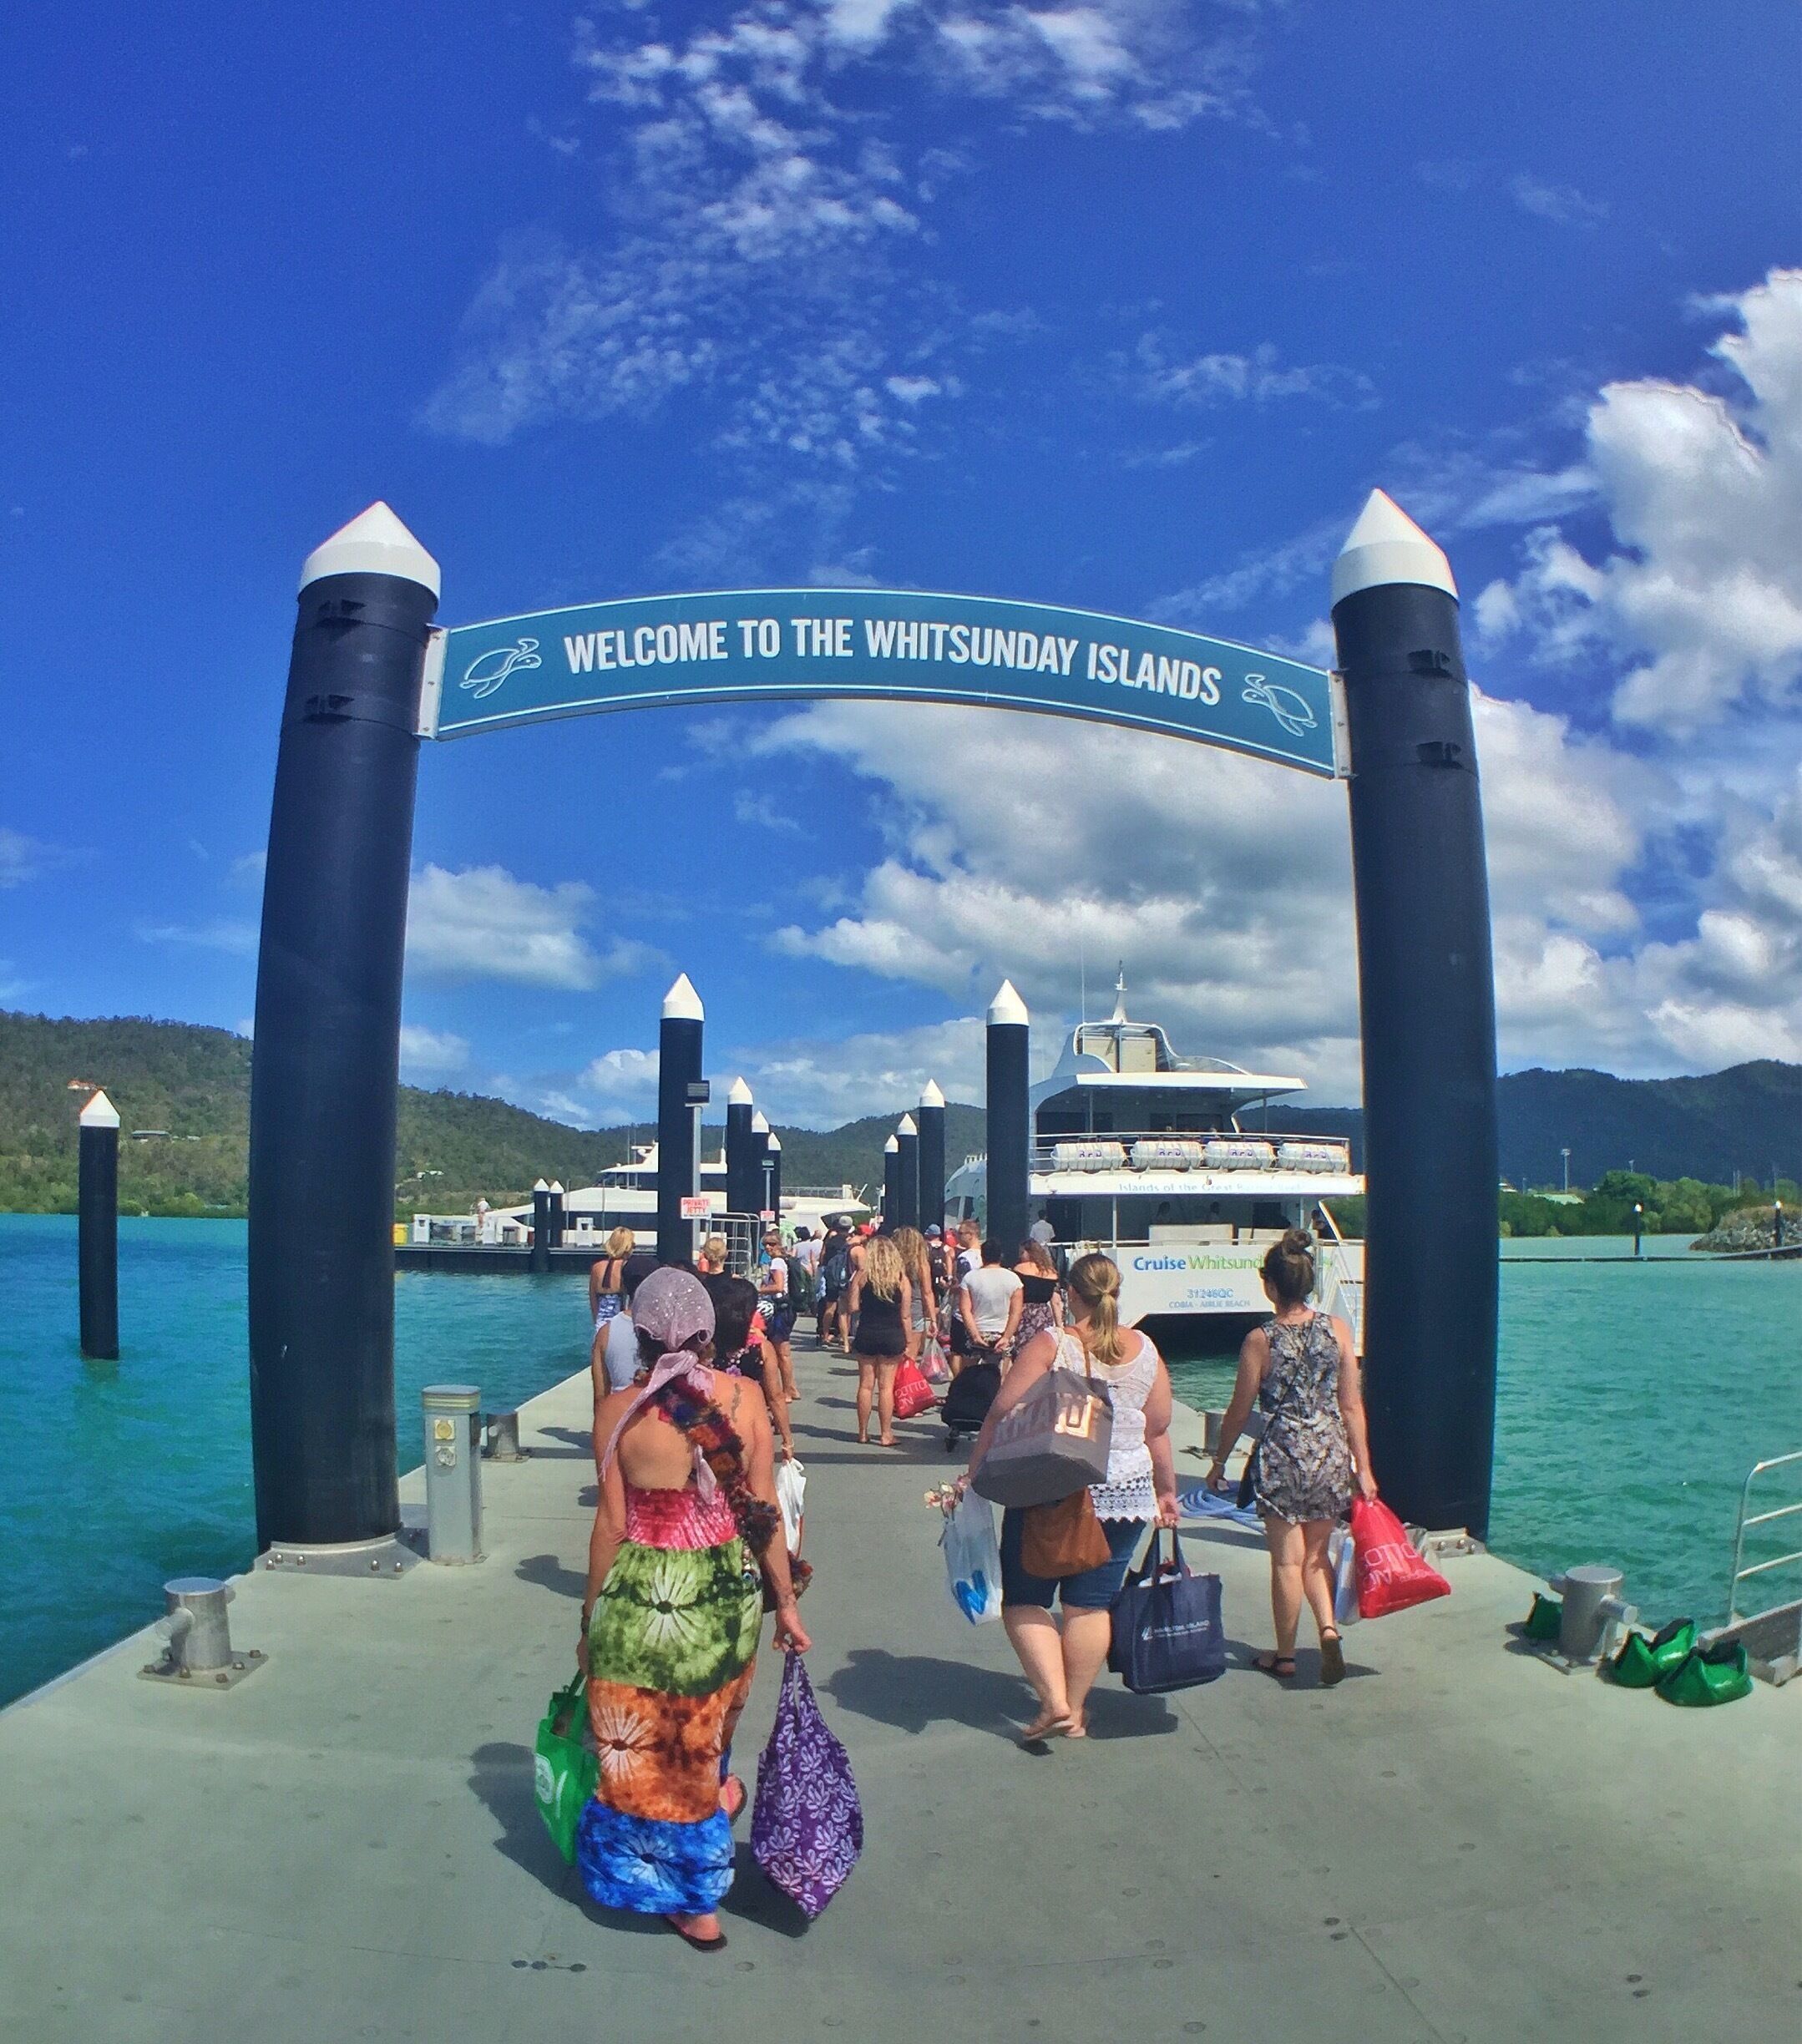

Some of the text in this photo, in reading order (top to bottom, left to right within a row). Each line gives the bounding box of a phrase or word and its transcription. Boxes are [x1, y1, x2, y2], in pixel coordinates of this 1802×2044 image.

[564, 618, 1222, 706] WELCOME TO THE WHITSUNDAY ISLANDS
[1119, 1183, 1159, 1192] Islands
[1163, 1183, 1174, 1192] of
[1179, 1183, 1197, 1192] the
[683, 1198, 709, 1207] PRIVATE
[1133, 1254, 1264, 1271] Cruise Whitsund
